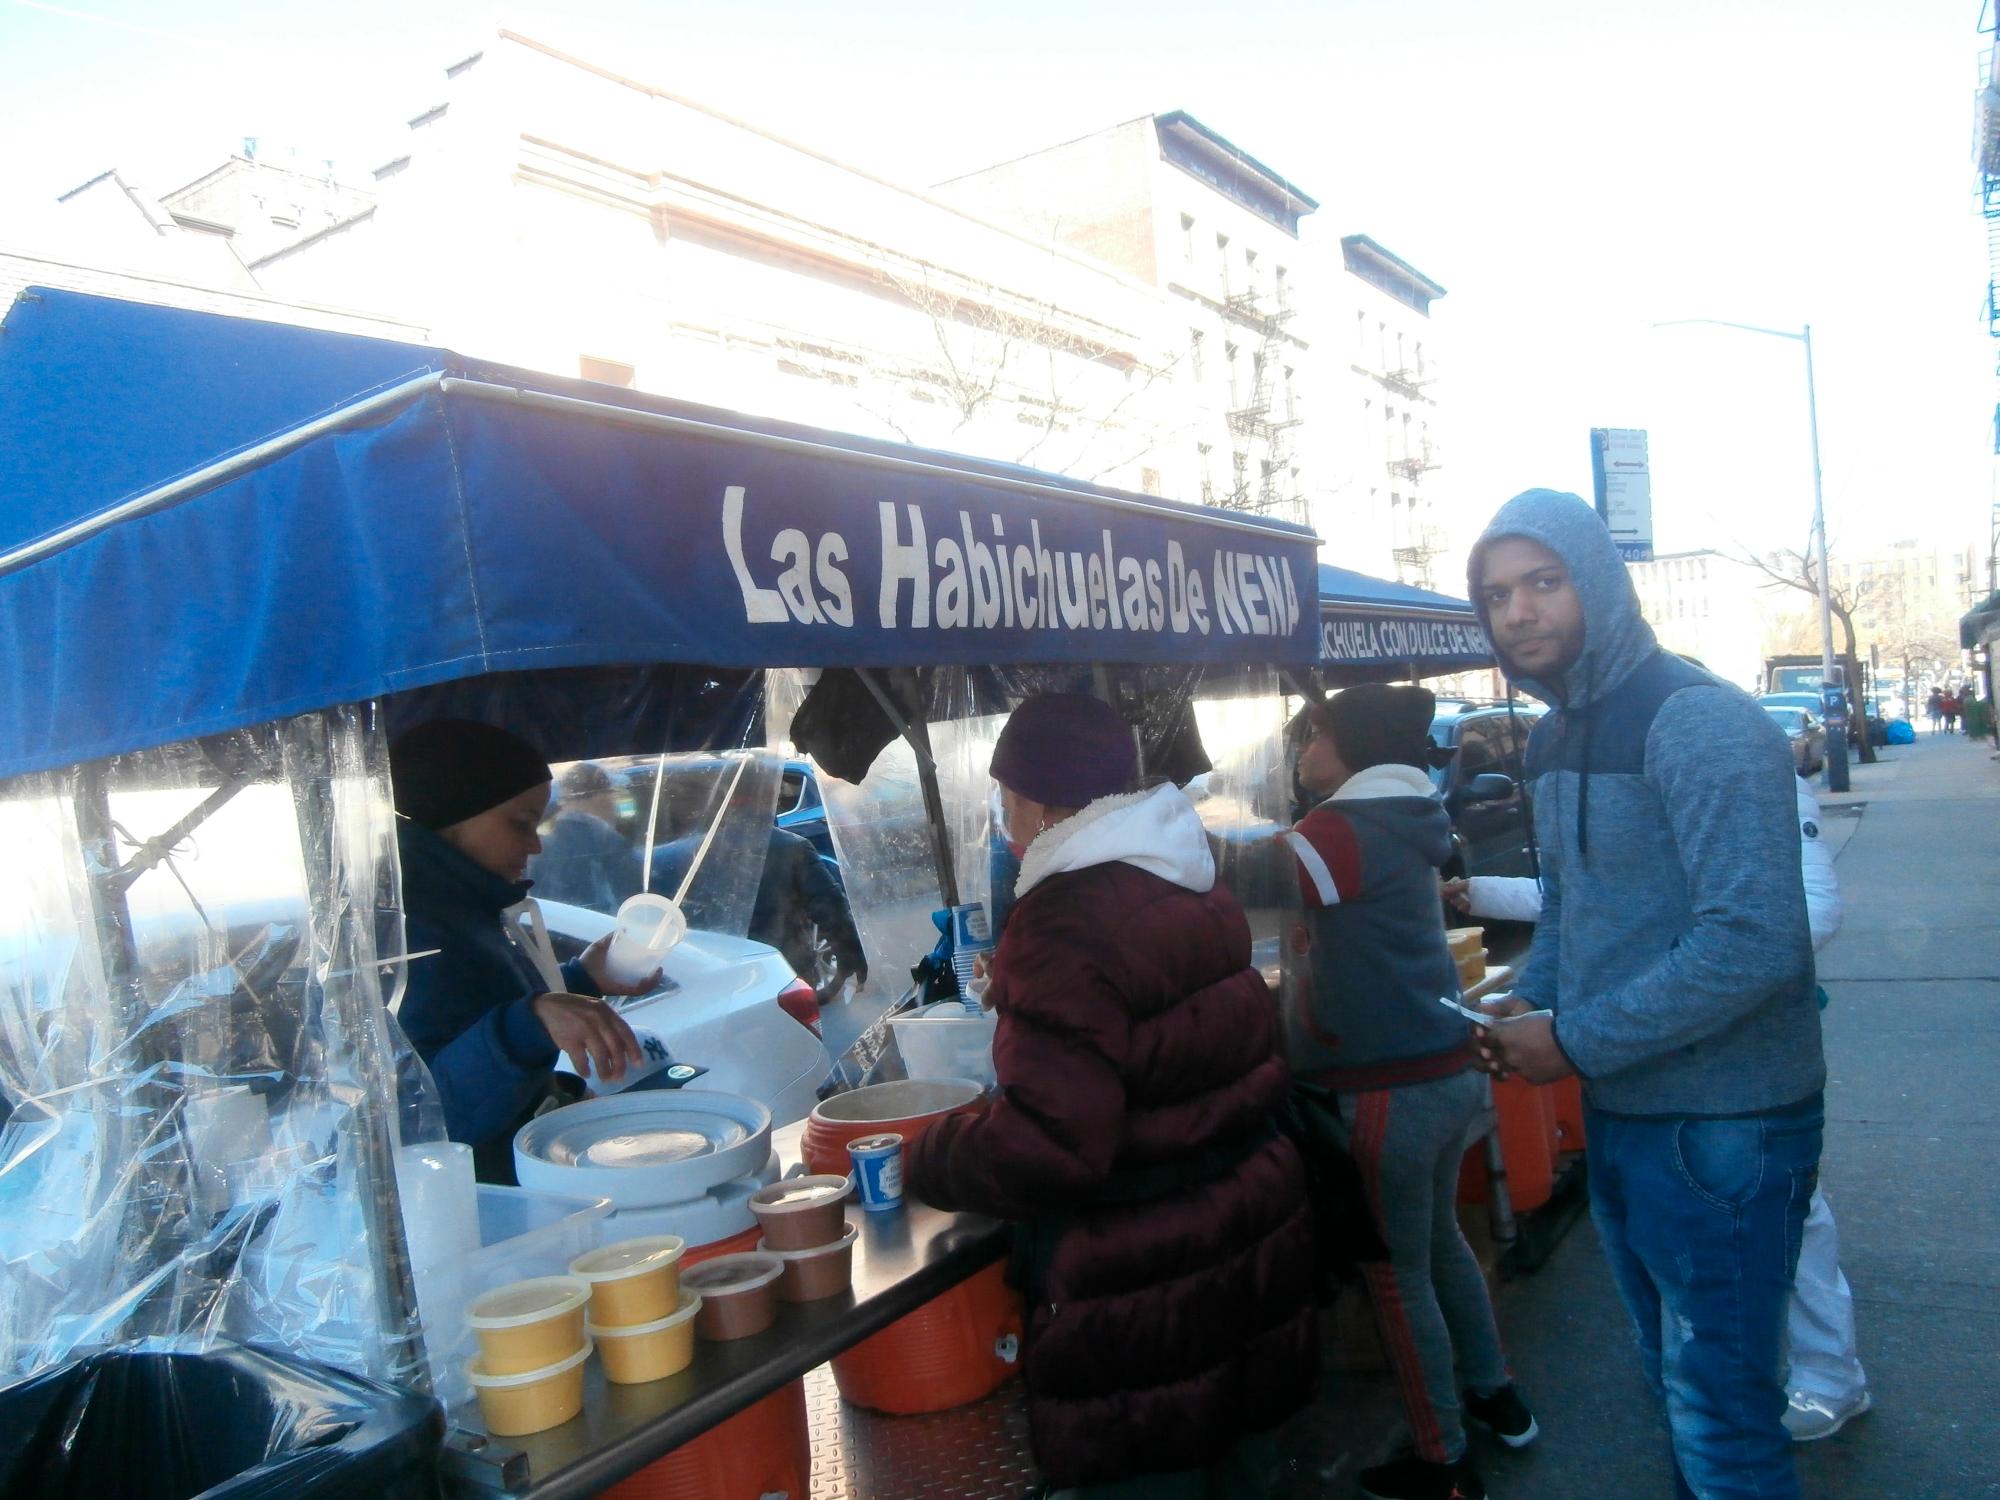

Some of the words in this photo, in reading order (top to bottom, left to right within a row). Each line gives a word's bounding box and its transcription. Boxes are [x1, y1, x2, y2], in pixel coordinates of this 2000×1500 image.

[722, 485, 854, 628] Las
[878, 500, 1164, 632] Habichuelas
[1166, 540, 1210, 636] De
[1212, 549, 1300, 637] NENA
[1380, 621, 1410, 657] CON
[1408, 622, 1451, 656] DULCE
[1446, 623, 1469, 654] DE
